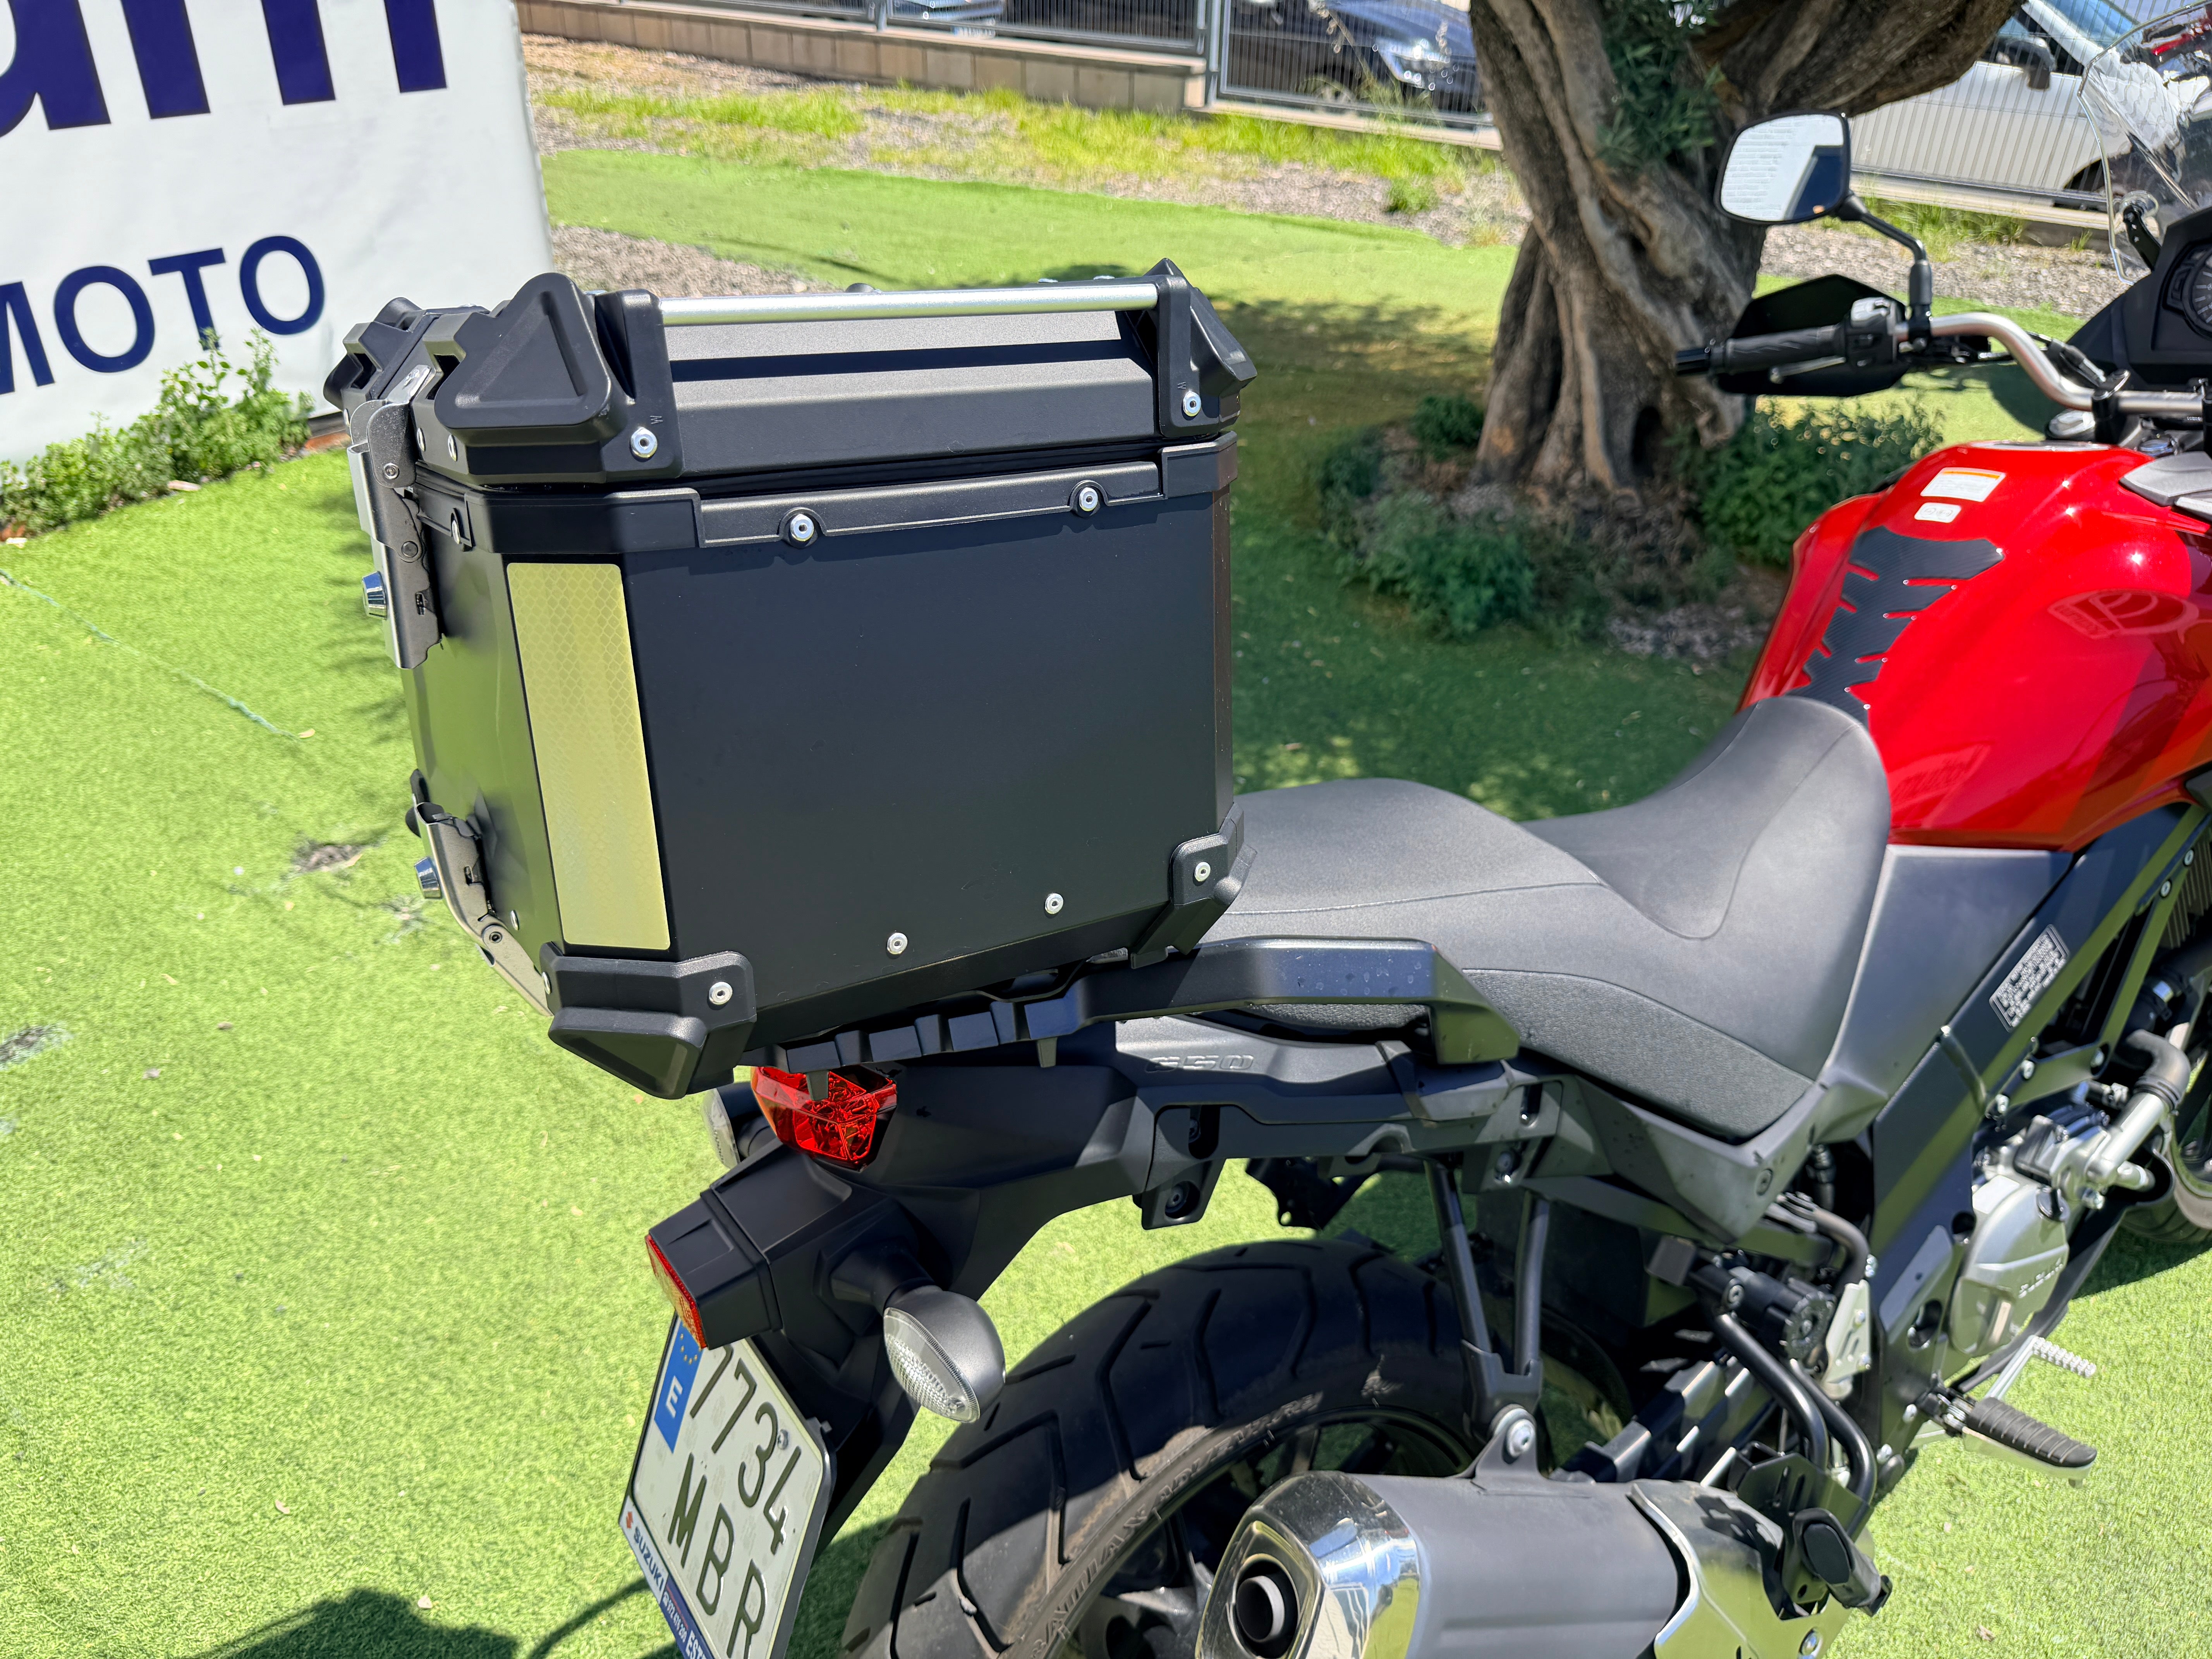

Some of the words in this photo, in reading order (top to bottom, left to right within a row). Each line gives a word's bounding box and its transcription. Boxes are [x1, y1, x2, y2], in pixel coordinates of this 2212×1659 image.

[1145, 1055, 1254, 1073] 650
[666, 1376, 683, 1419] E
[690, 1343, 802, 1556] 7734
[634, 1526, 665, 1592] SUZUKI
[667, 1451, 768, 1659] MBR
[686, 1629, 707, 1659] EST
